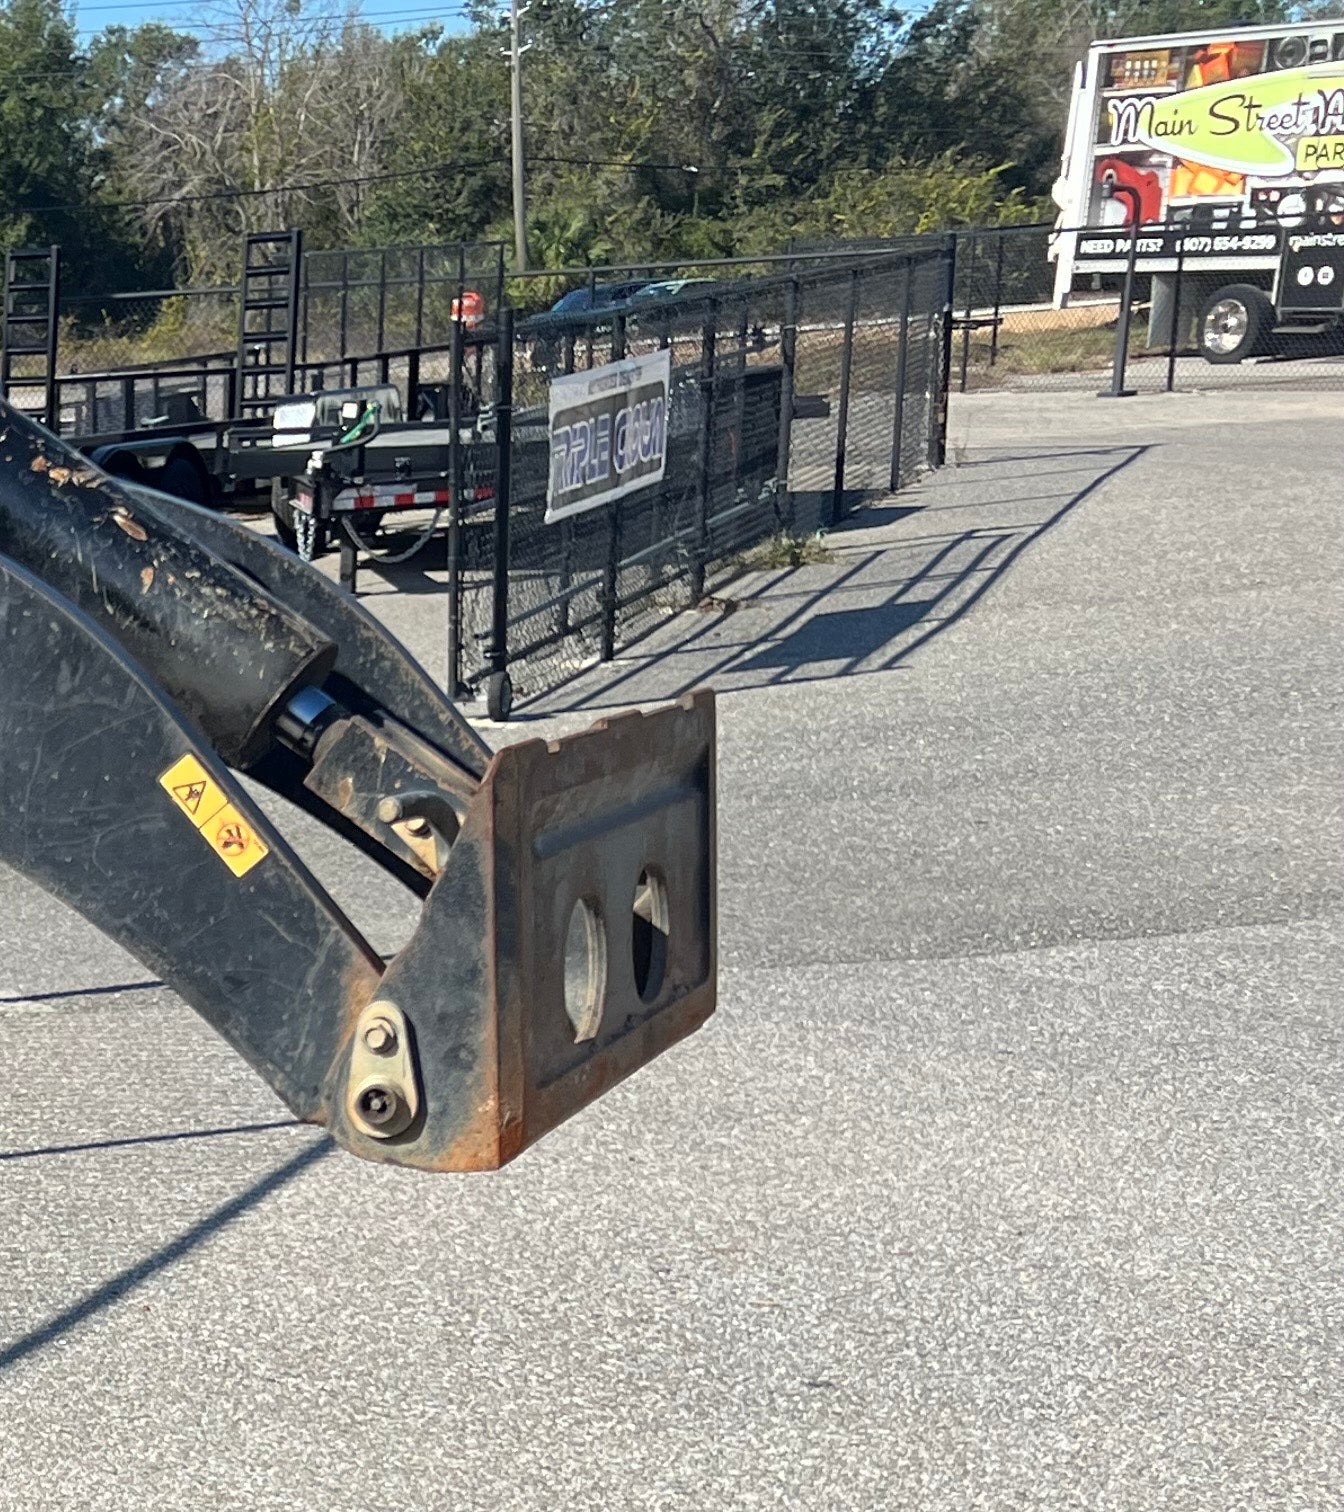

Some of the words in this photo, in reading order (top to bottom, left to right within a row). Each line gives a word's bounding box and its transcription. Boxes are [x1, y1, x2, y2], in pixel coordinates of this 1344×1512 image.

[1110, 100, 1196, 143] Main
[1209, 91, 1310, 136] Street
[1080, 239, 1115, 254] NEED
